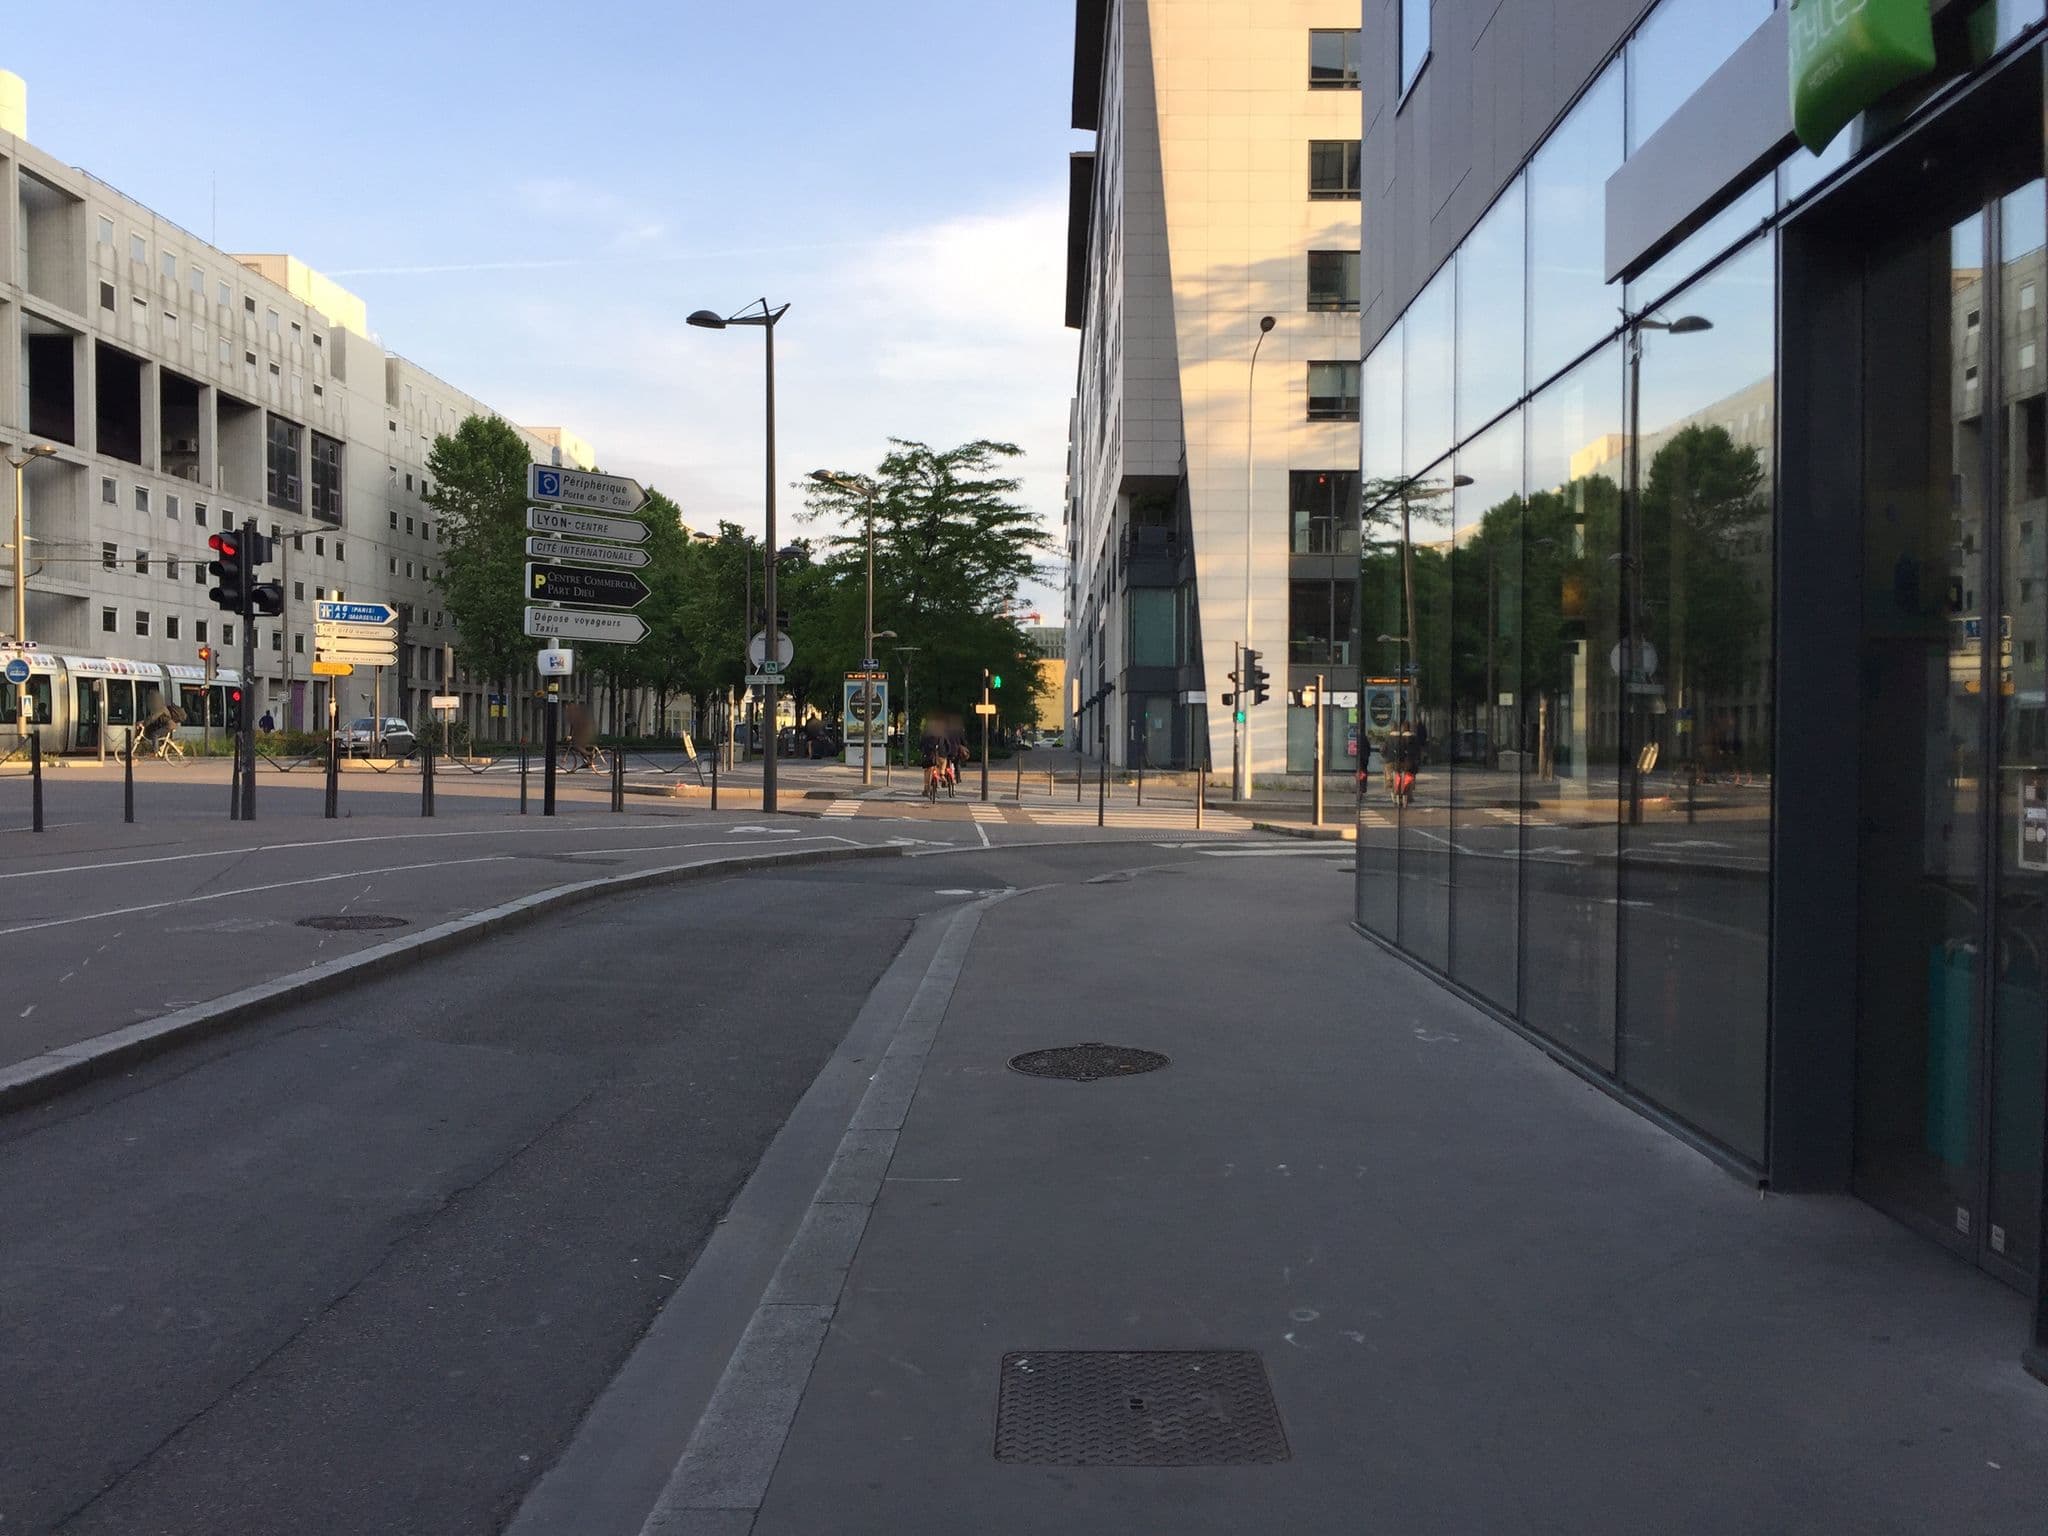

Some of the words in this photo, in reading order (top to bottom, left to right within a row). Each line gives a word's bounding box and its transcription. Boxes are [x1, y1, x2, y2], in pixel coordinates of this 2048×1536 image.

[563, 475, 628, 494] Périphérique
[562, 489, 585, 500] Porte
[587, 493, 597, 501] de
[612, 496, 632, 506] Clair
[574, 521, 609, 533] CENTRE
[536, 542, 557, 553] CITÉ
[560, 546, 634, 561] INTERNATIONALE
[534, 612, 569, 623] Dépose
[574, 618, 621, 628] voyageurs
[535, 623, 559, 633] Taxis
